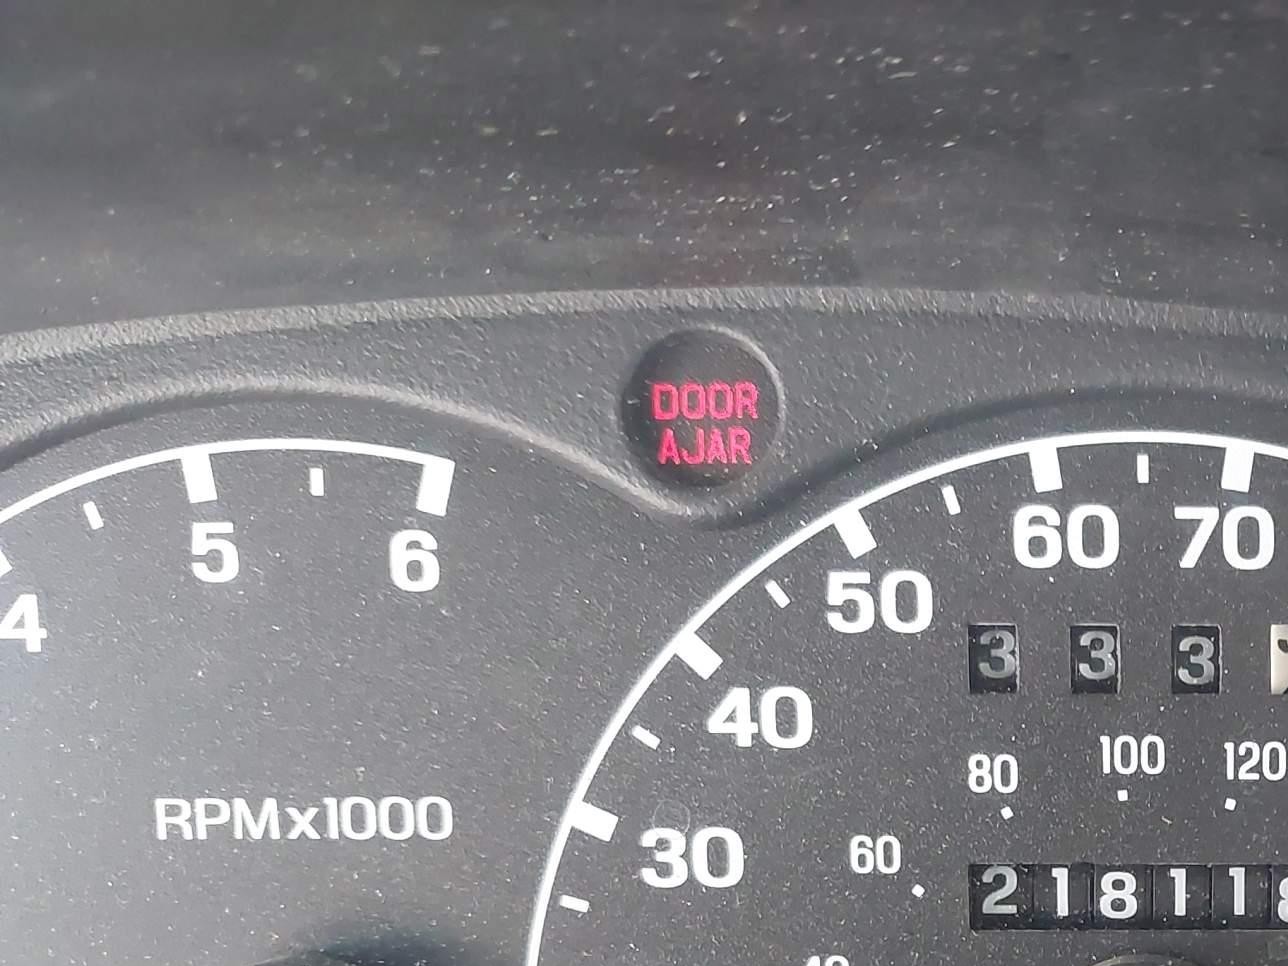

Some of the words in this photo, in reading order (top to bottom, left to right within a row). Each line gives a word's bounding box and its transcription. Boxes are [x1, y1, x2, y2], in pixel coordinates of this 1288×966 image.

[652, 382, 759, 420] DOOR
[658, 429, 752, 465] AJAR
[191, 523, 240, 584] 5
[390, 531, 440, 593] 6
[1013, 505, 1119, 569] 60
[1174, 505, 1275, 569] 70
[0, 594, 47, 652] 4
[826, 571, 933, 634] 50
[707, 686, 813, 749] 40
[968, 755, 1018, 794] 80
[1100, 735, 1165, 775] 100
[1224, 742, 1287, 782] 120
[154, 797, 454, 841] RPMx1000
[641, 827, 745, 888] 30
[849, 836, 901, 874] 60
